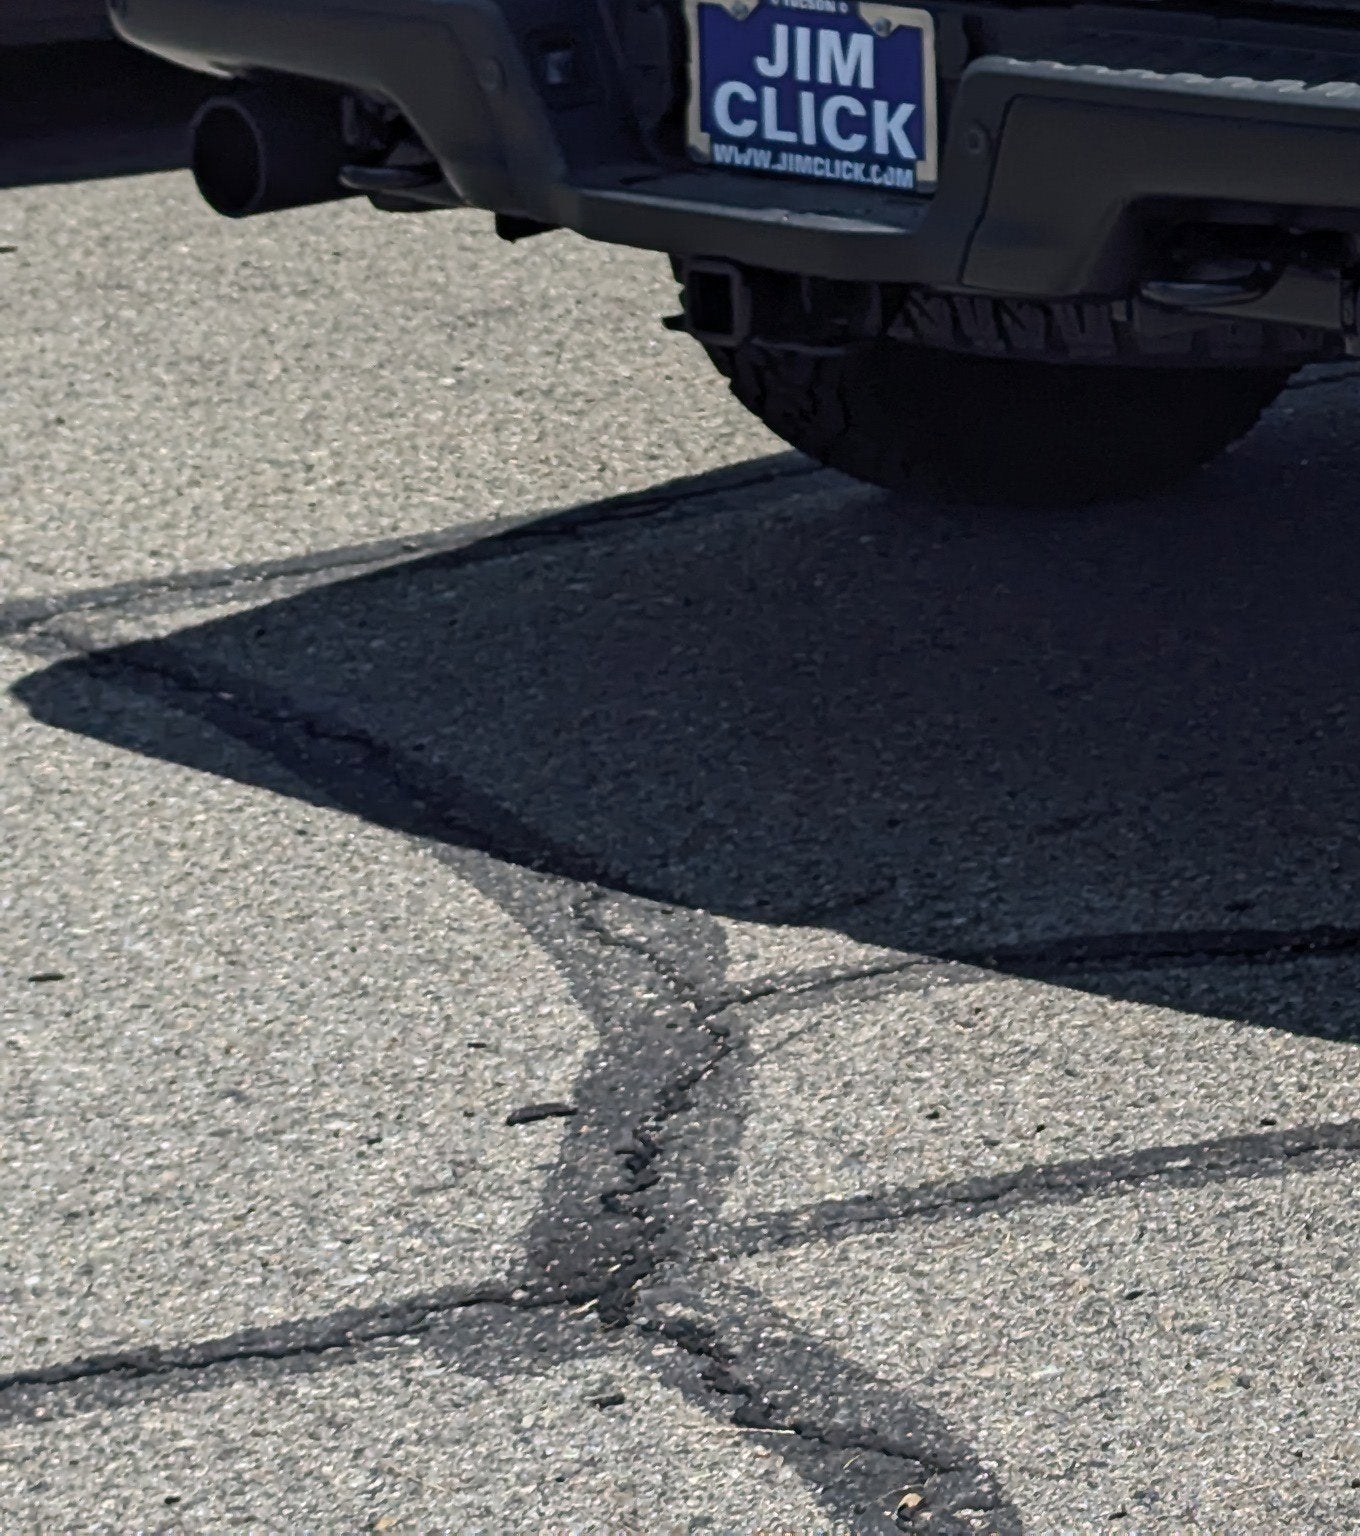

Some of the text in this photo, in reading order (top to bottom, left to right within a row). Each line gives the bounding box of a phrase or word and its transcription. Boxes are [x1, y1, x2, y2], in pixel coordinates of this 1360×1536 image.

[754, 23, 875, 89] JIM
[713, 81, 918, 161] CLICK
[713, 144, 913, 188] WWW.JIMCLICK.COM
